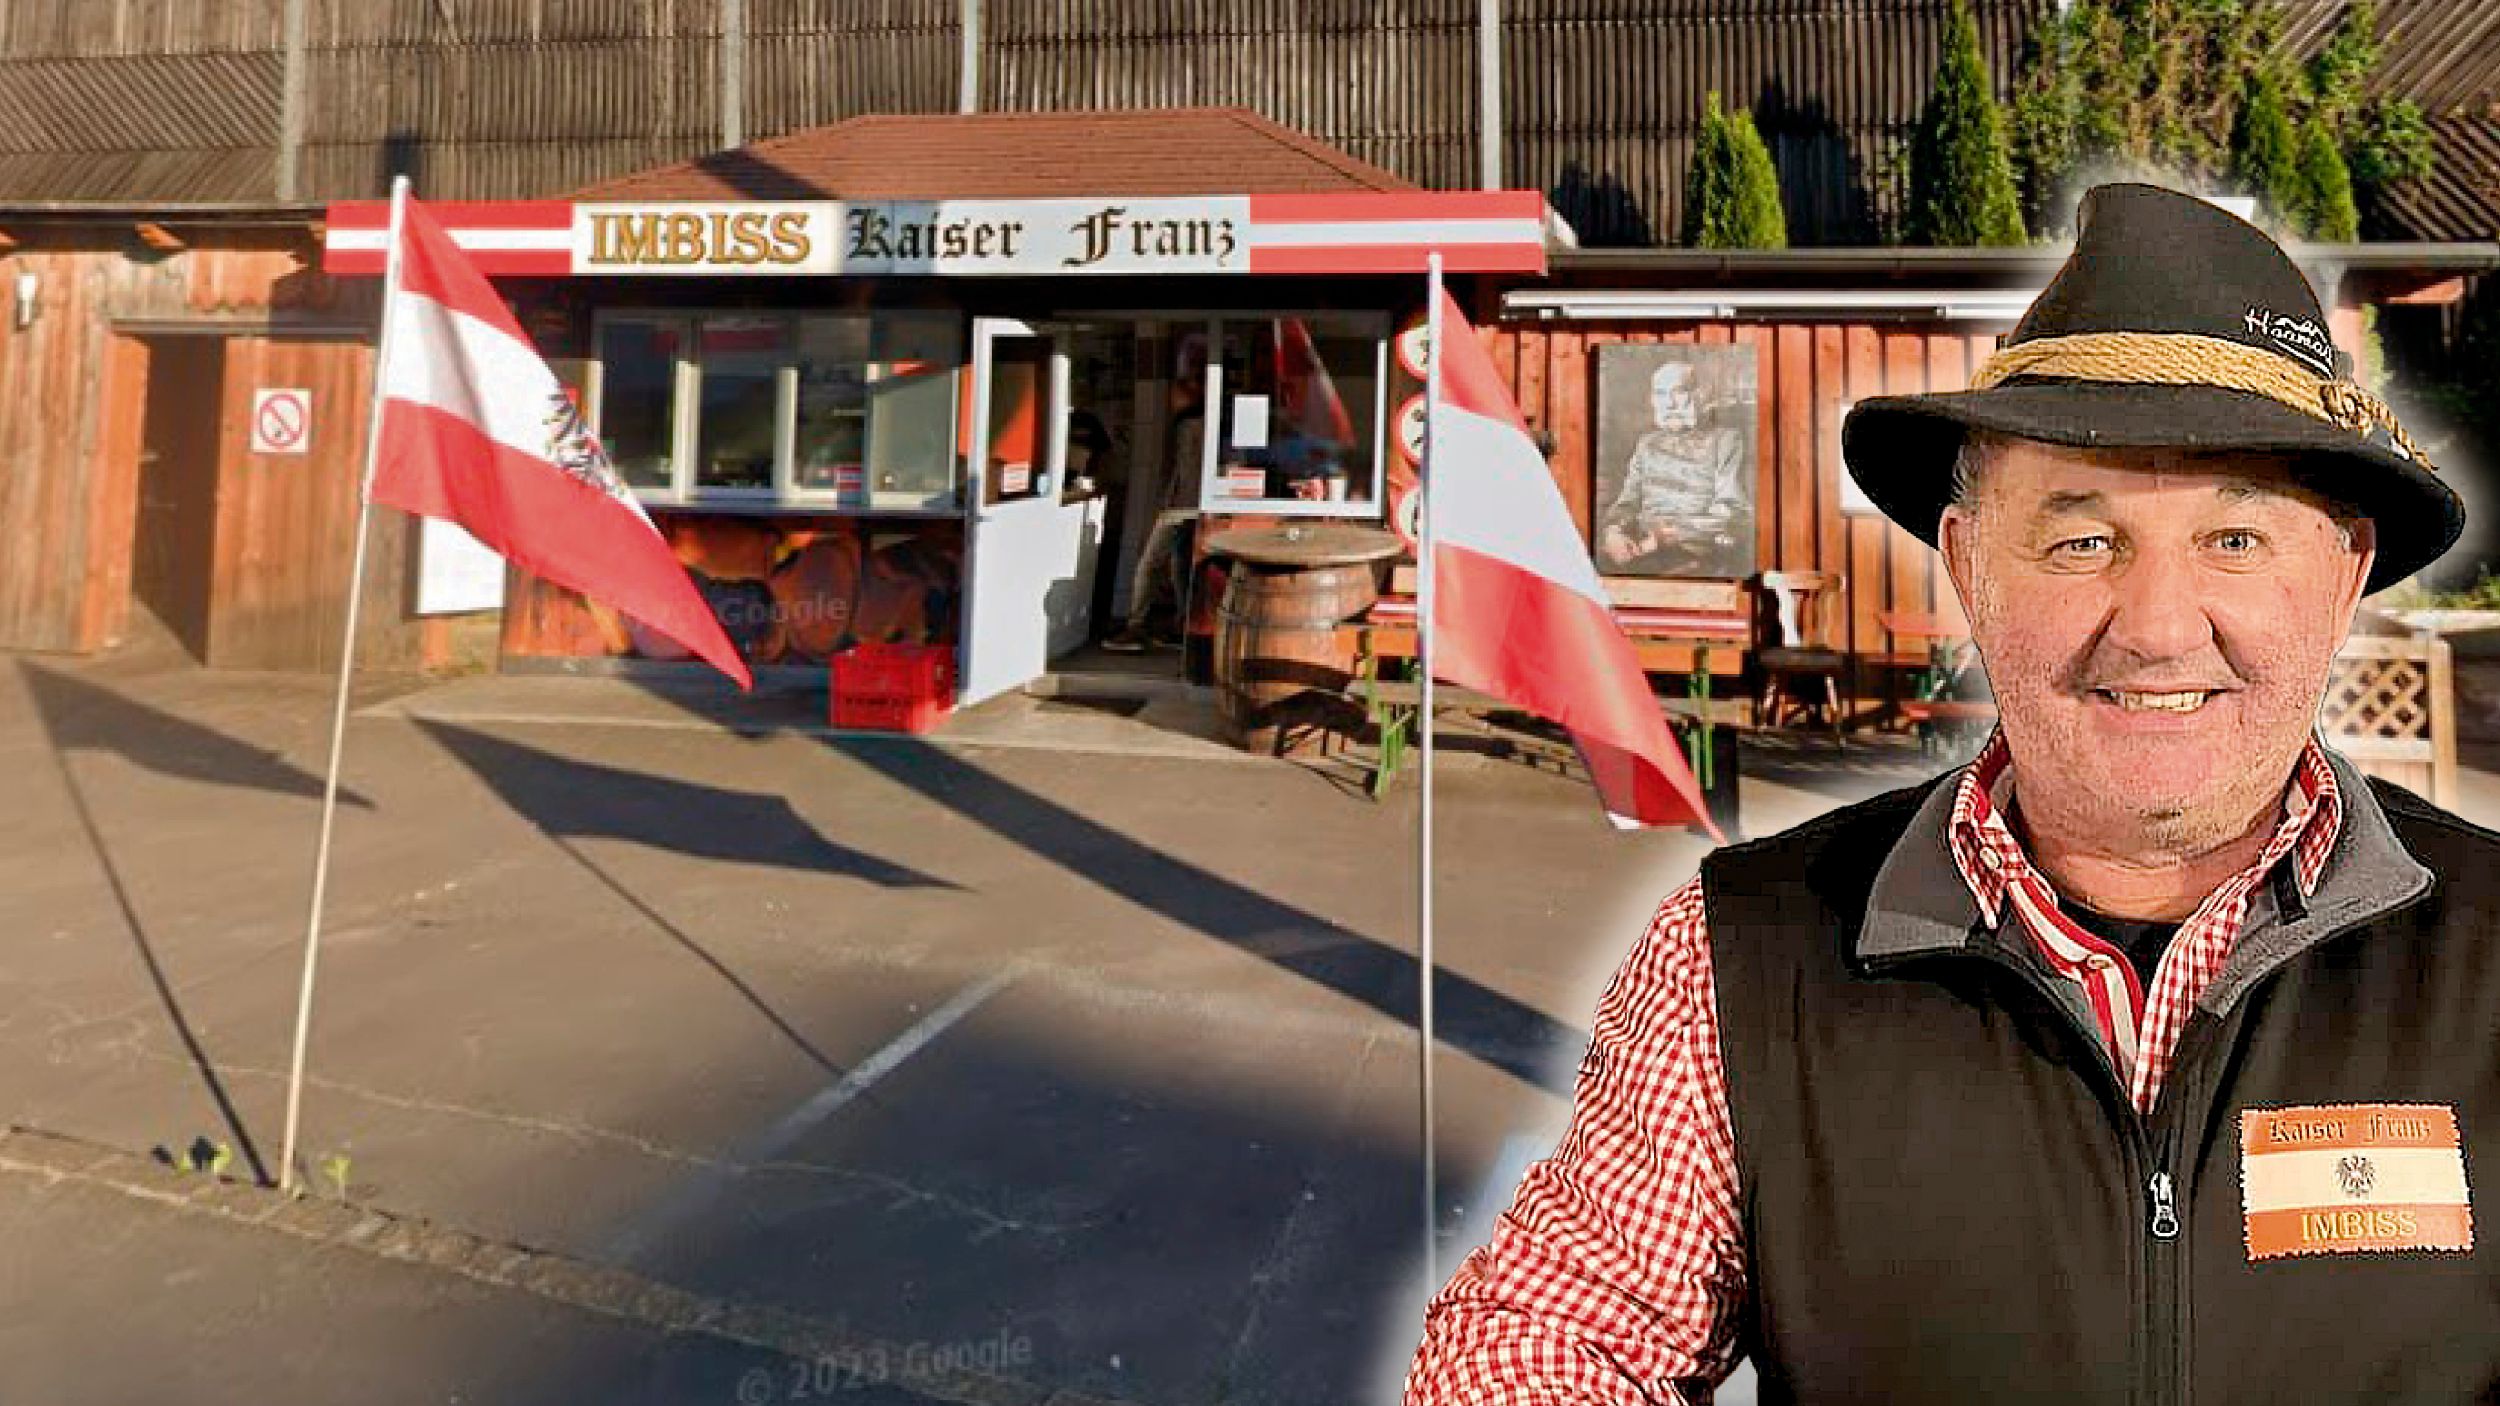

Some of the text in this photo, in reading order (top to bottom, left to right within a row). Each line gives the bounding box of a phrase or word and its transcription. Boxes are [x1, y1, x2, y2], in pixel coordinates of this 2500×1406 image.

[588, 205, 1237, 267] IMBISS Kaiser Franz
[2268, 1116, 2348, 1144] Kaiser
[2301, 1208, 2417, 1242] IMBISS
